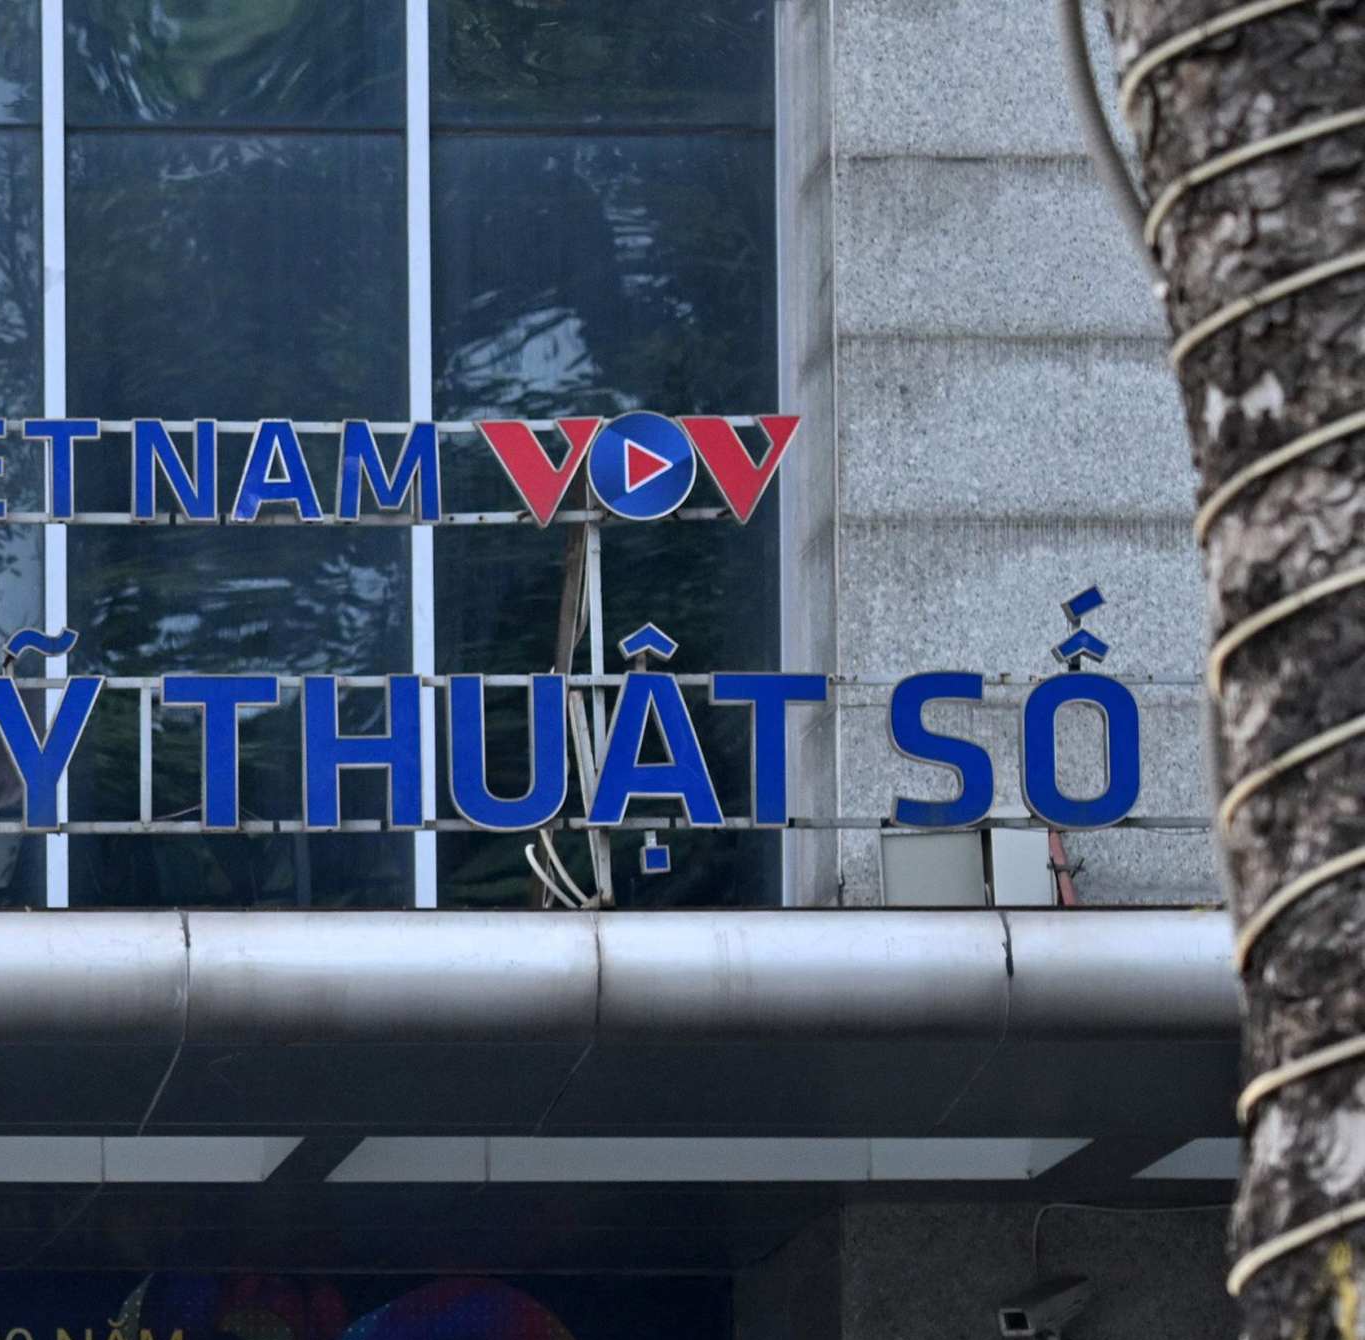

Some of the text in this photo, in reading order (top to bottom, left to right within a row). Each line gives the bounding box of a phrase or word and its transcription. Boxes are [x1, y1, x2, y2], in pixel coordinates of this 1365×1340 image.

[130, 417, 443, 523] NAM
[475, 410, 802, 528] VOV
[159, 621, 829, 875] THUẬT
[887, 584, 1142, 831] SỐ
